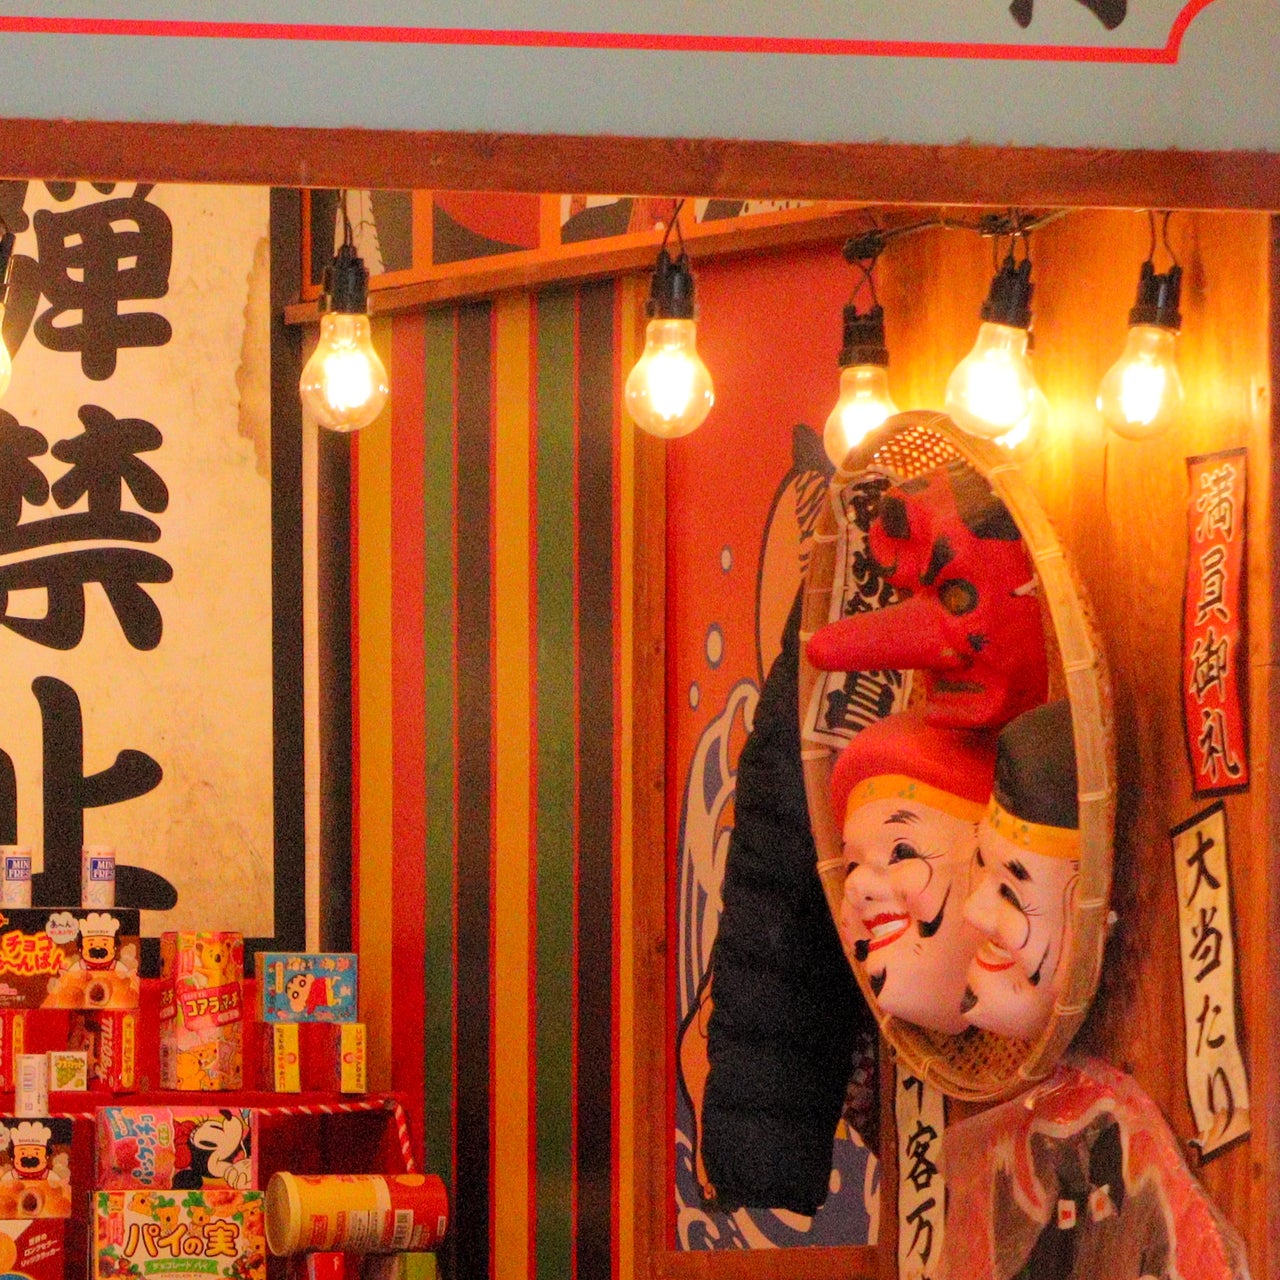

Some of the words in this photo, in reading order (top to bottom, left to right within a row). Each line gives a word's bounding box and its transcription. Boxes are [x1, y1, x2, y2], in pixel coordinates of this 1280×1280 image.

[1190, 467, 1241, 785] 満員御礼
[6, 934, 52, 952] チョコ
[1187, 830, 1238, 1145] 大当たり
[125, 1219, 240, 1258] パイの実
